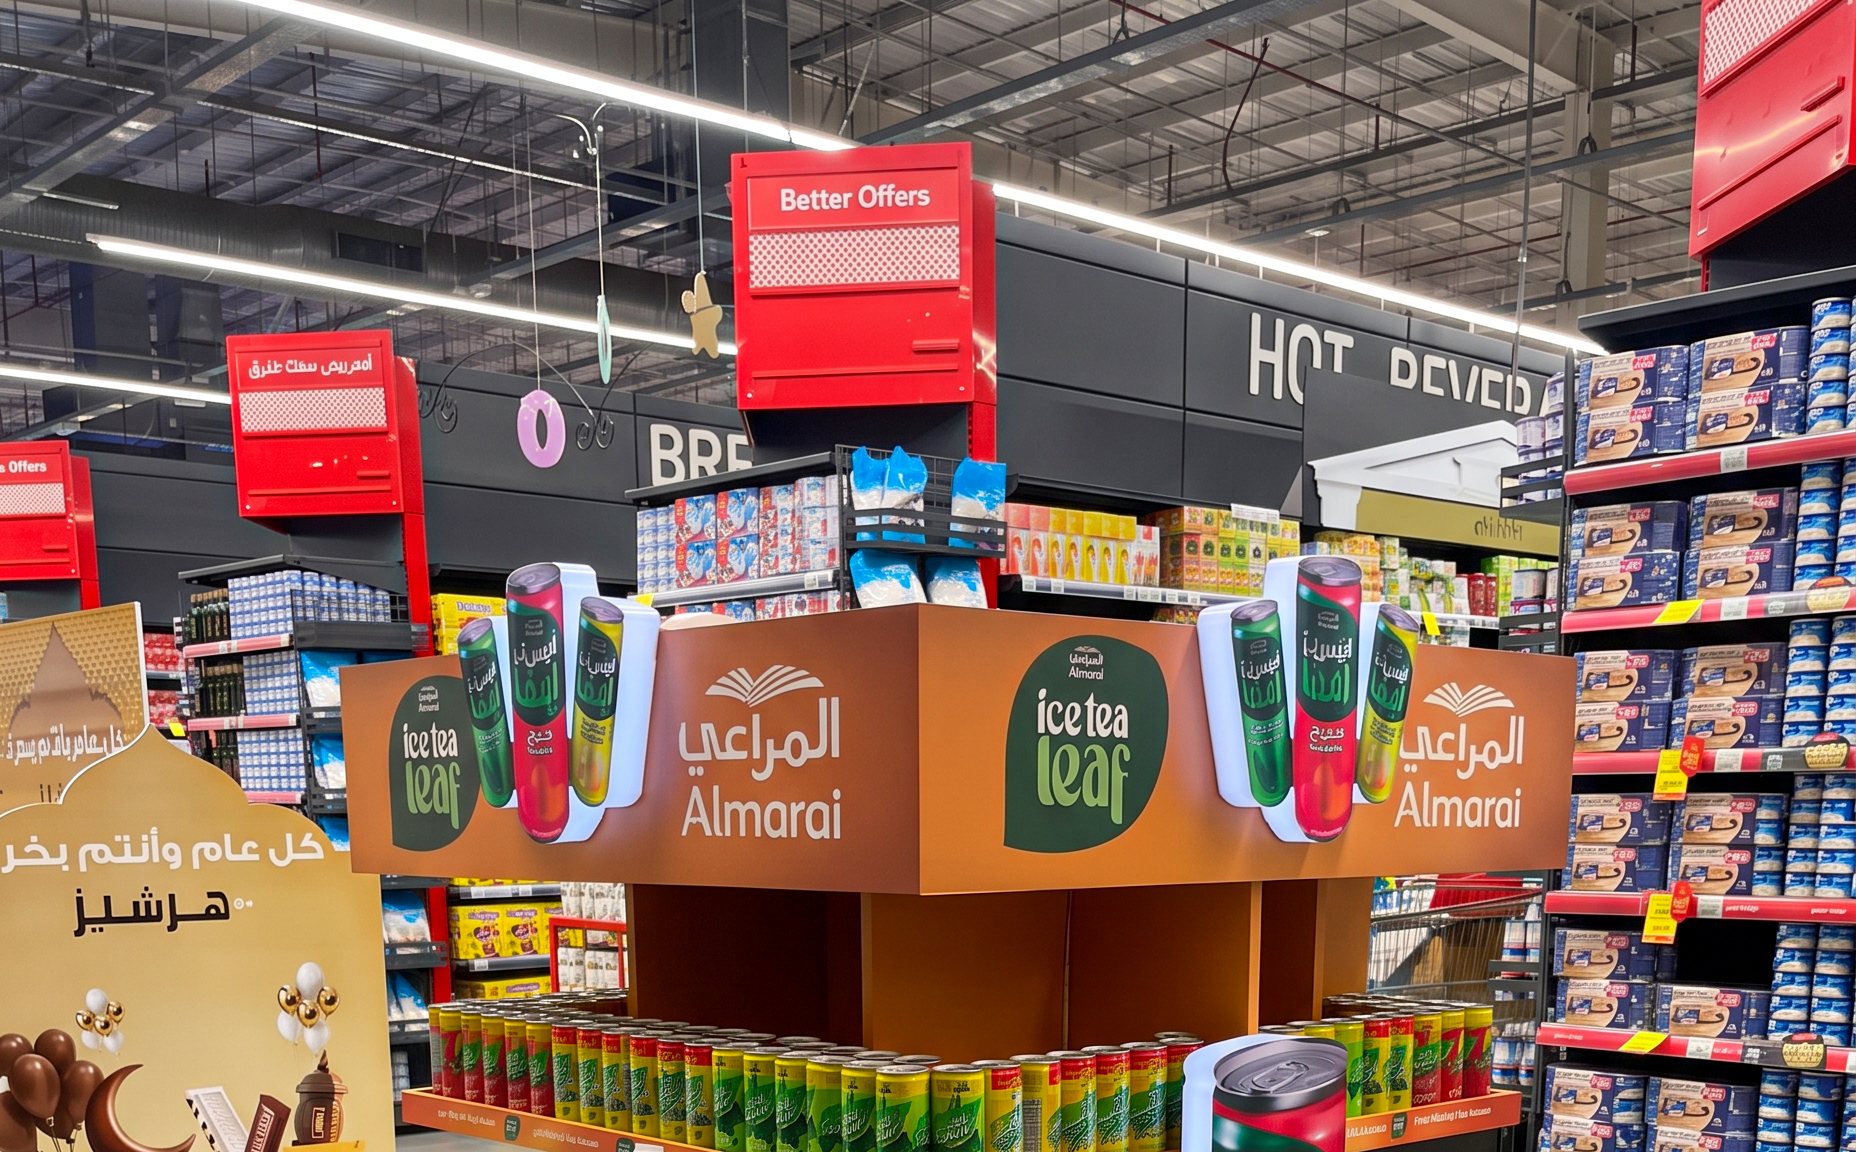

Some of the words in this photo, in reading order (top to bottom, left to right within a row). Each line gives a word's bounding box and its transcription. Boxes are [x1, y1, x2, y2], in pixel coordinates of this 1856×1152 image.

[780, 186, 853, 213] Better
[858, 183, 931, 210] Offers
[8, 459, 48, 474] Offers
[1037, 687, 1082, 737] ice
[1084, 691, 1129, 739] tea
[403, 722, 430, 759] ice
[430, 721, 459, 759] tea
[679, 697, 840, 782] المراعي
[1399, 715, 1524, 781] المراعي
[405, 760, 461, 830] leaf
[1037, 735, 1131, 825] leaf
[681, 785, 841, 841] Almarai
[1394, 781, 1521, 829] Almarai
[79, 826, 183, 873] وأنتم
[191, 833, 261, 871] عام
[268, 831, 325, 868] كل
